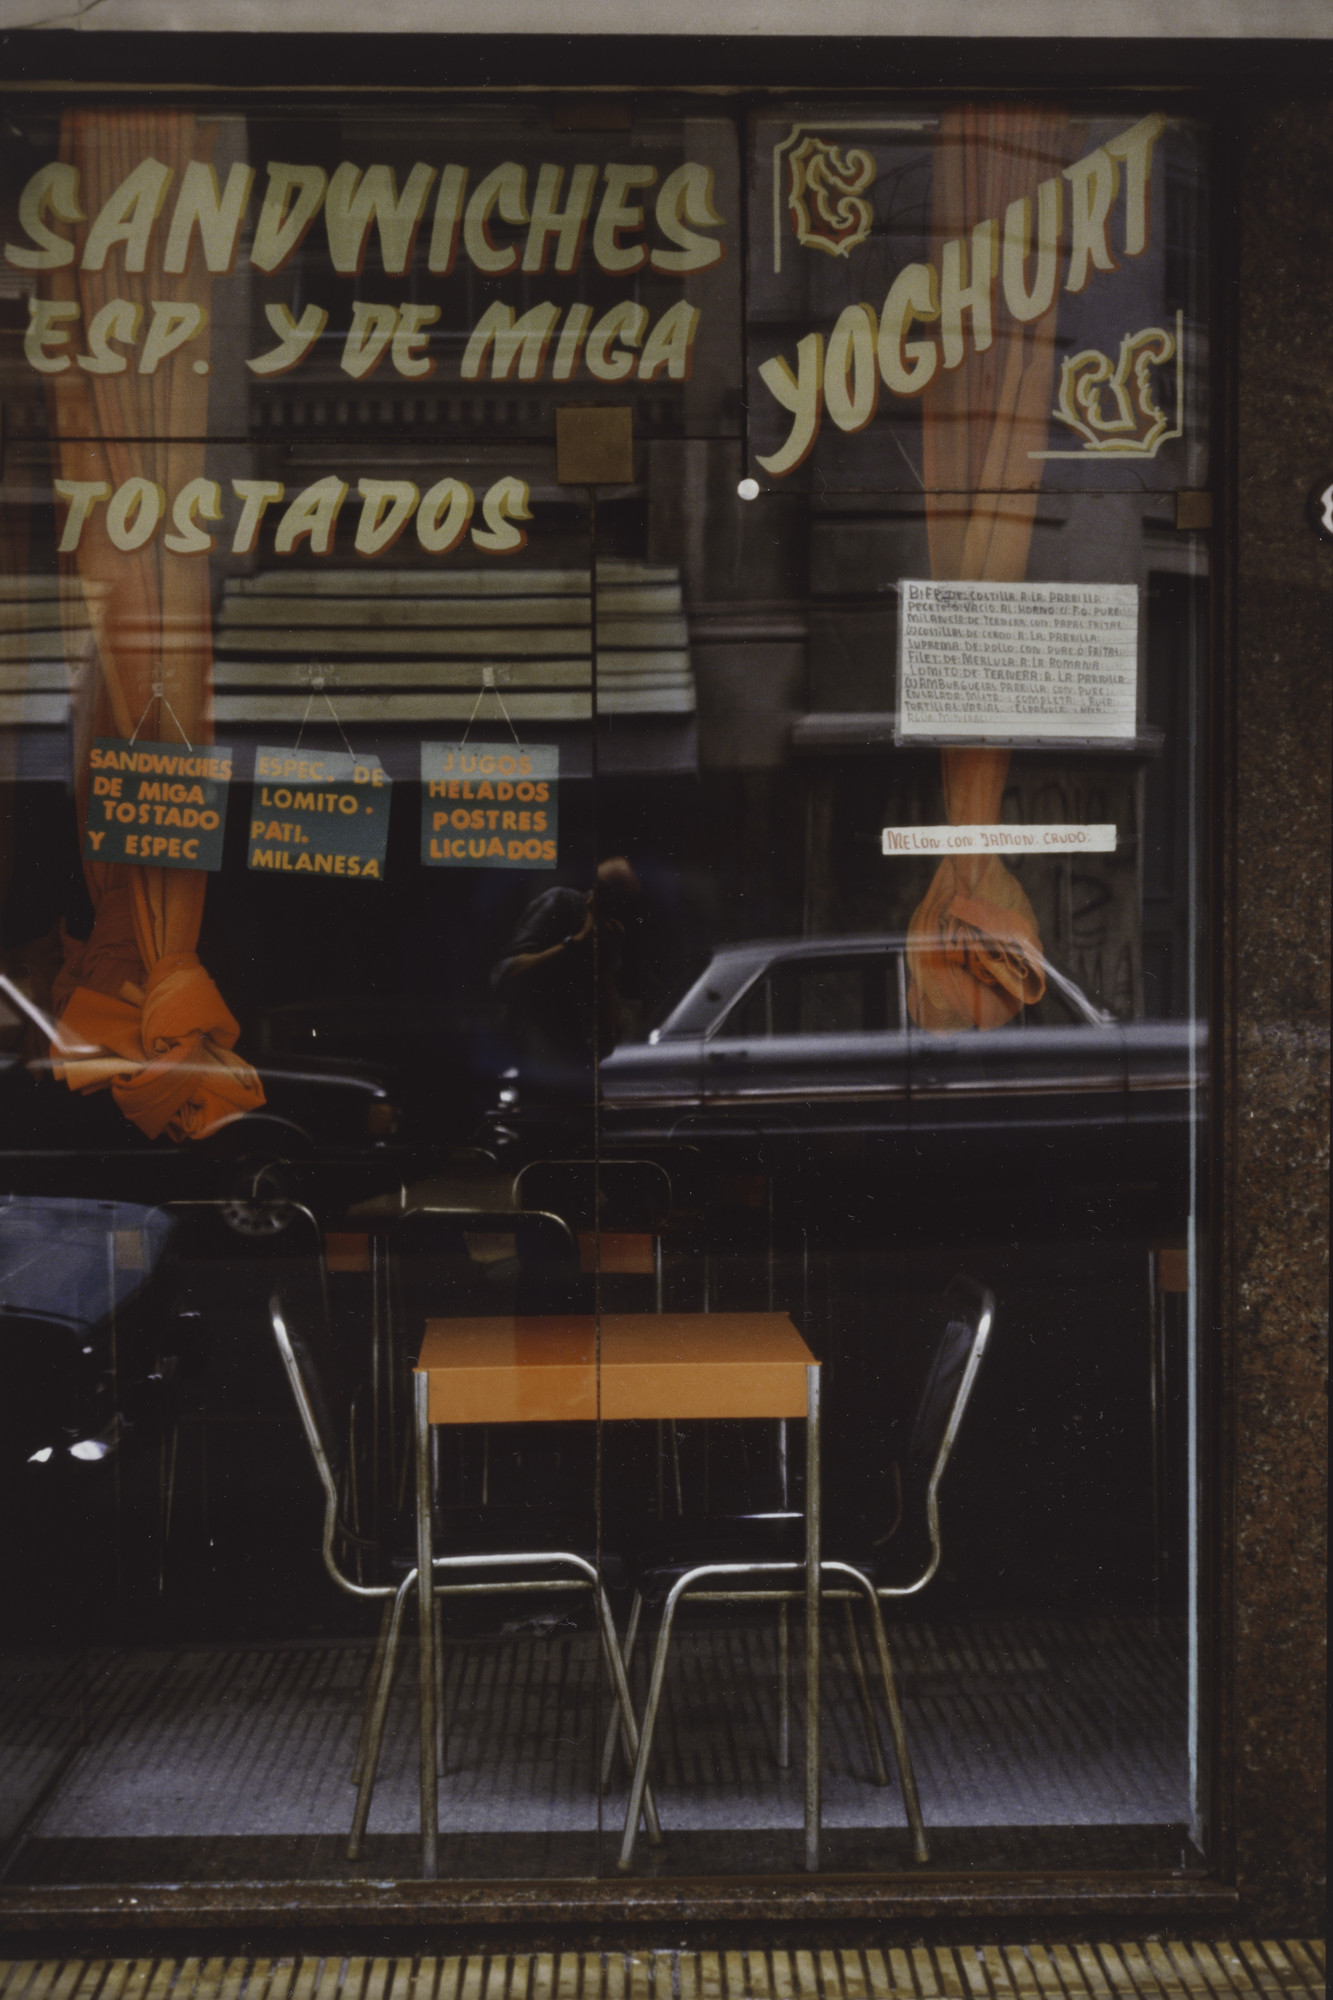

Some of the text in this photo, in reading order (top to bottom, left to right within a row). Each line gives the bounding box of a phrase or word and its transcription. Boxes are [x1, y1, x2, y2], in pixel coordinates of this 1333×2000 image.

[3, 156, 728, 277] SANDWICHES
[754, 110, 1166, 478] YOGHURT
[24, 298, 700, 383] ESP. Y DE MIGA
[54, 475, 534, 557] TOSTADOS
[1018, 604, 1054, 615] HORNO
[1049, 657, 1099, 670] ROMANA
[89, 748, 233, 781] SANDWICHES
[258, 756, 384, 787] ESPEC. DE
[443, 753, 532, 776] JUGOS
[93, 775, 205, 805] DE MIGA
[429, 779, 550, 803] HELADOS
[103, 800, 220, 831] TOSTADO
[432, 808, 548, 832] POSTRES
[88, 830, 200, 860] Y ESPEC
[251, 820, 309, 844] PATI.
[251, 848, 380, 878] MILANESA
[429, 836, 557, 861] LICUADOS
